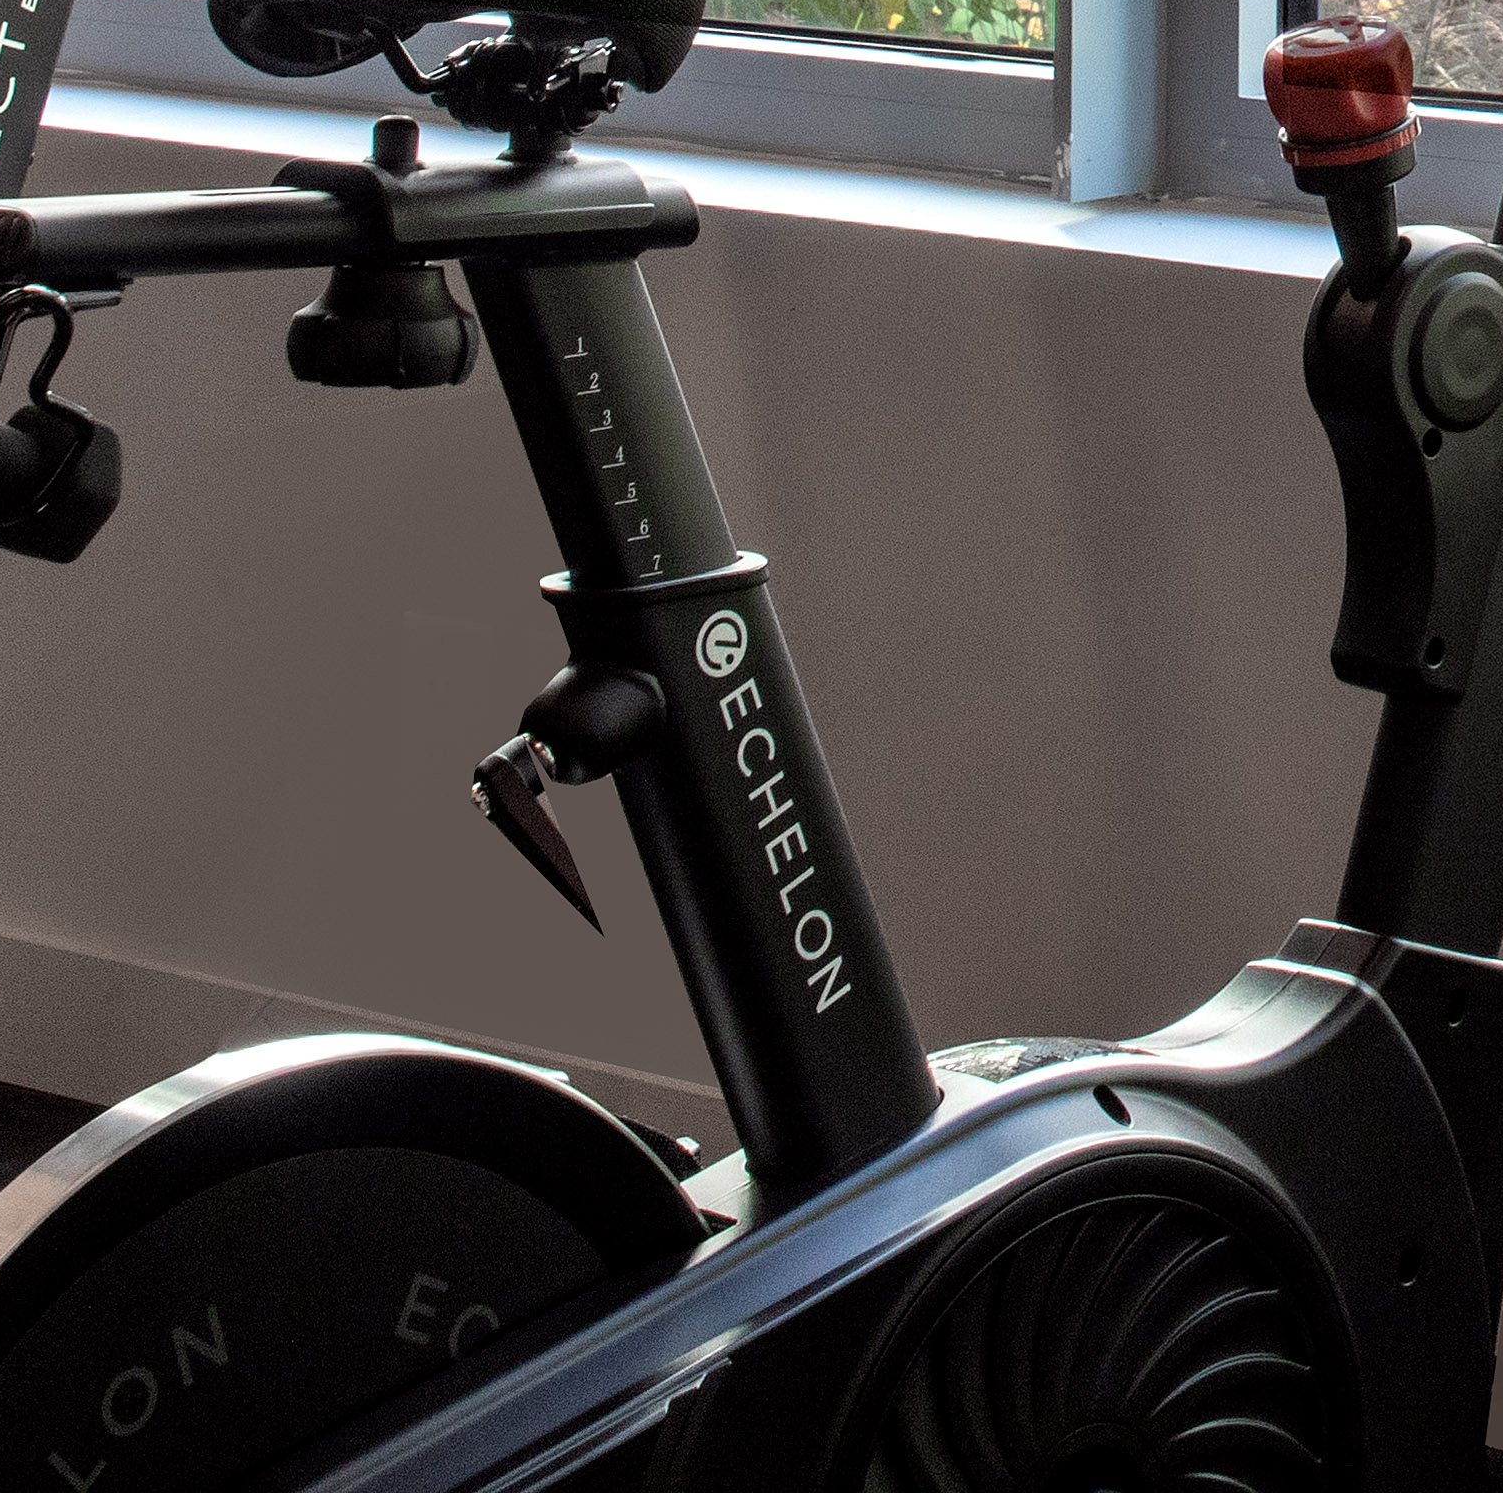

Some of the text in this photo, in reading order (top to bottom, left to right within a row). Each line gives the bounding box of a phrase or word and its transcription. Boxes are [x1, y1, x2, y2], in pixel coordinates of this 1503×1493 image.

[577, 336, 584, 353] 1
[589, 372, 598, 389] 2
[603, 409, 611, 426] 3
[615, 445, 623, 462] 4
[627, 482, 636, 499] 5
[640, 518, 648, 535] 6
[653, 554, 661, 571] 7
[718, 677, 852, 1015] ECHELON
